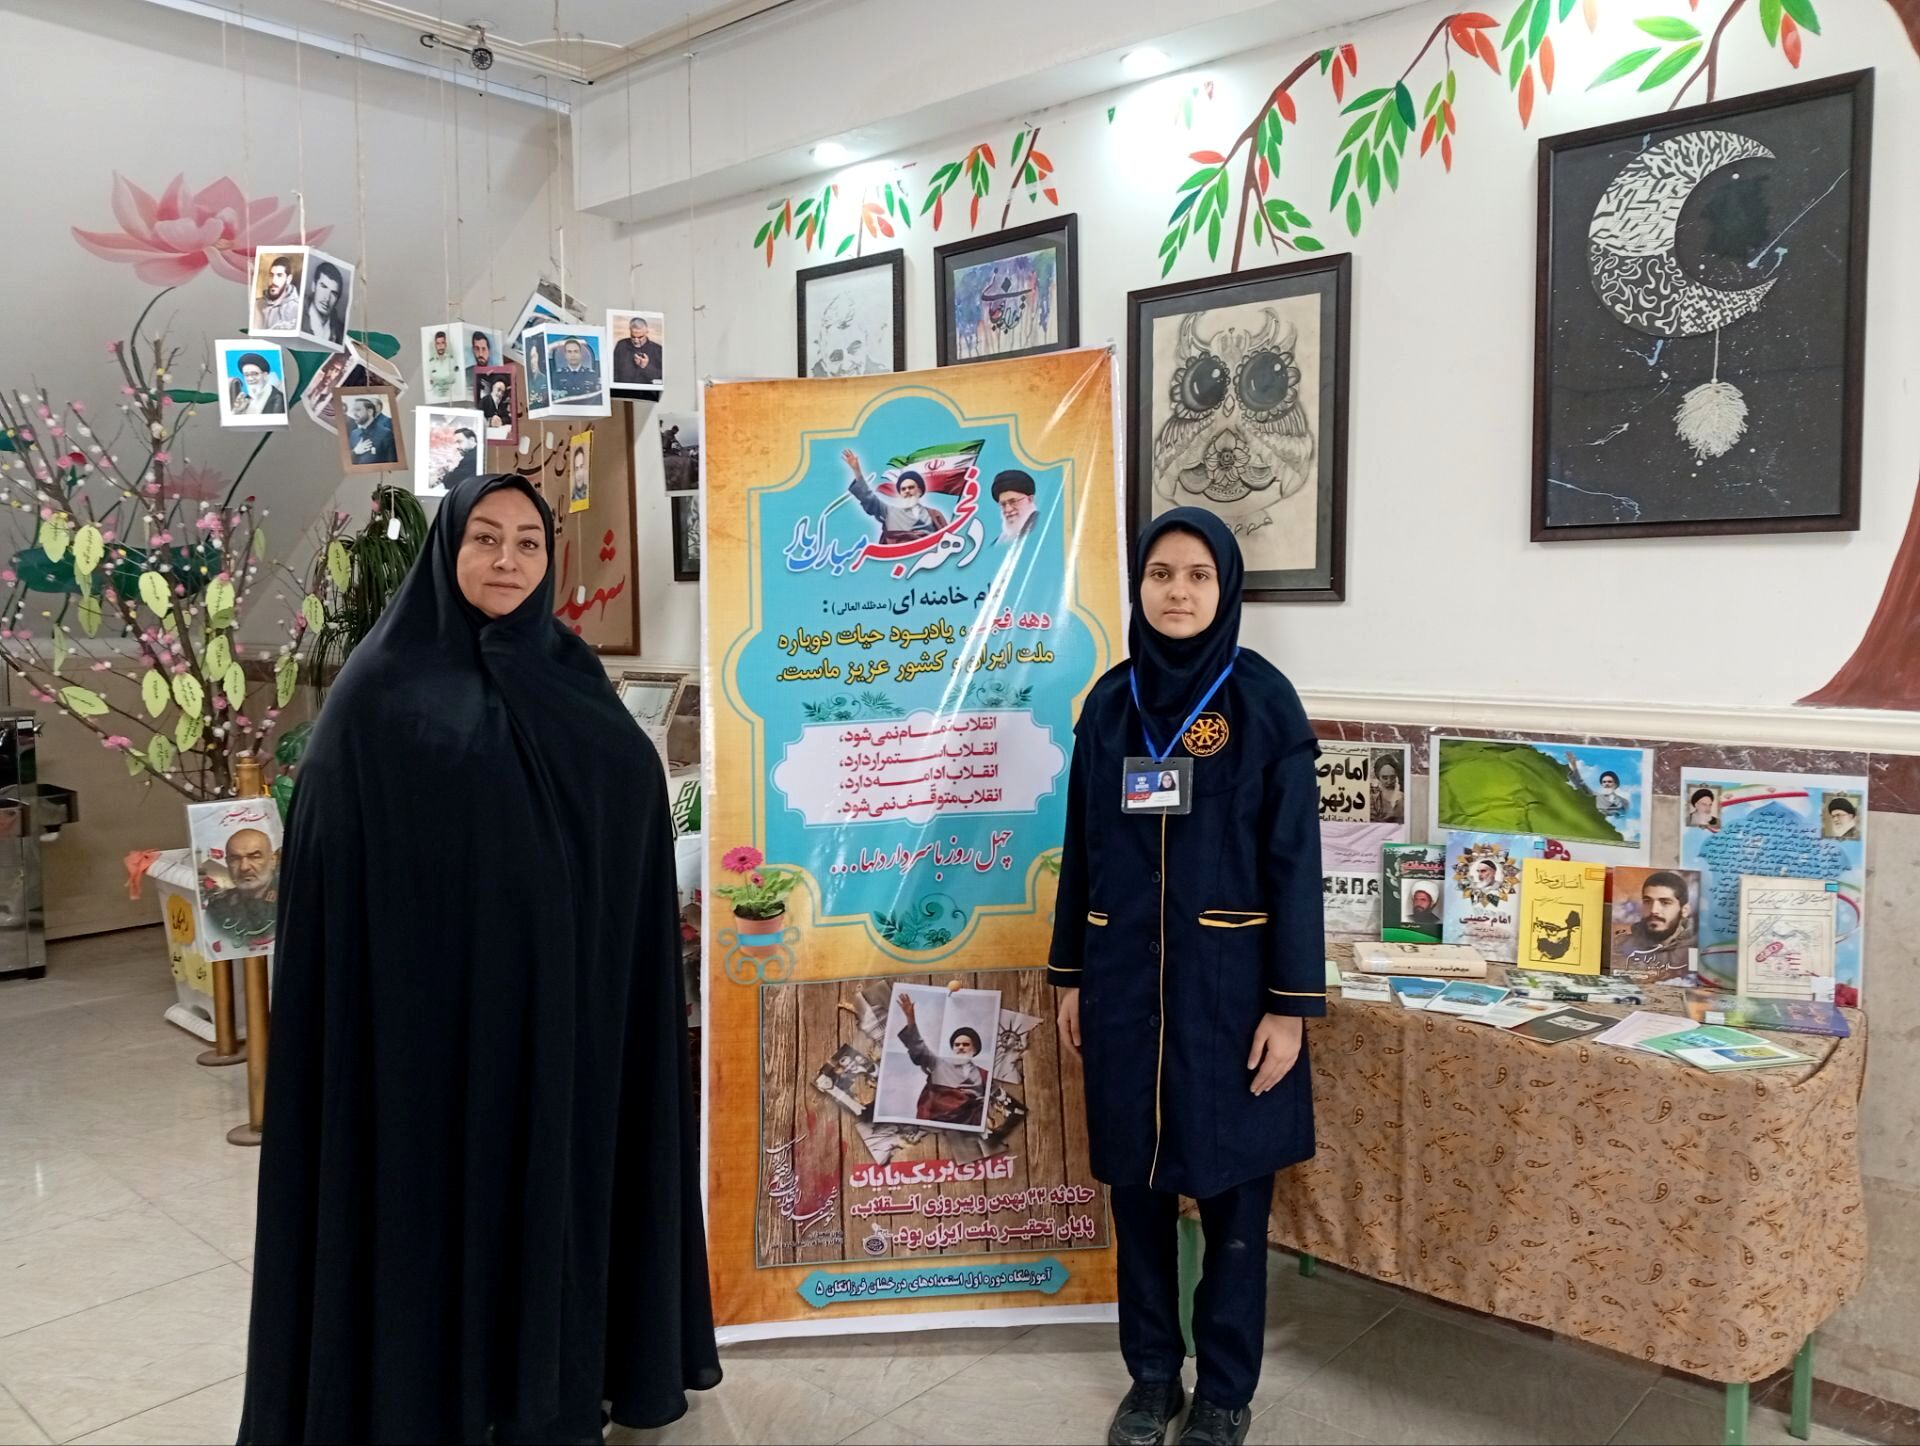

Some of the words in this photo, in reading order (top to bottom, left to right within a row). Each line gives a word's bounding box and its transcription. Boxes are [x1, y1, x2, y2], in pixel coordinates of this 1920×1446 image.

[851, 467, 981, 577] فجر
[906, 517, 985, 580] دهه
[892, 588, 915, 616] ای
[919, 586, 968, 607] خامنه
[1018, 611, 1052, 630] دهه
[778, 626, 832, 656] دوباره
[836, 624, 884, 650] حیات
[889, 617, 955, 650] یادبود
[965, 642, 1013, 673] ایران
[1015, 641, 1055, 664] ملت
[776, 658, 841, 683] ماست.
[846, 658, 890, 684] عزیز
[895, 649, 947, 682] کشور
[899, 719, 952, 746] تمام
[952, 716, 998, 737] انقلاب
[839, 752, 872, 772] دارد،
[869, 744, 946, 771] استمرار
[946, 742, 999, 763] انقلاب
[873, 766, 946, 788] ادامه
[946, 764, 999, 785] انقلاب
[1331, 757, 1369, 786] امام
[839, 775, 873, 794] دارد،
[958, 788, 1003, 809] انقلاب
[1319, 786, 1345, 814] تهر
[1340, 792, 1366, 813] در
[885, 843, 934, 874] سردار
[933, 841, 945, 881] با
[944, 835, 974, 866] روز
[974, 830, 1013, 873] چهل
[1459, 913, 1490, 925] خمینی
[1491, 914, 1511, 927] امام
[849, 1165, 901, 1191] پایان
[900, 1162, 936, 1188] یک
[935, 1160, 955, 1184] بر
[954, 1156, 1017, 1181] آغازی
[977, 1195, 987, 1213] و
[989, 1194, 1026, 1213] بهمن
[1028, 1187, 1046, 1204] ۲۲
[1050, 1184, 1096, 1204] حادثه
[851, 1194, 921, 1218] انقلاب،
[923, 1196, 977, 1218] پیروزی
[893, 1227, 923, 1249] بود.
[924, 1222, 963, 1247] ایران
[966, 1221, 998, 1240] ملت
[1000, 1217, 1055, 1242] تحقیر
[1058, 1215, 1096, 1240] پایان
[816, 1280, 824, 1295] ۵
[826, 1278, 868, 1297] فرزانگان
[868, 1277, 908, 1294] درخشان
[908, 1271, 965, 1293] استعدادهای
[967, 1271, 983, 1288] اول
[983, 1274, 1007, 1288] دوره
[1008, 1267, 1053, 1285] آموزشگاه
